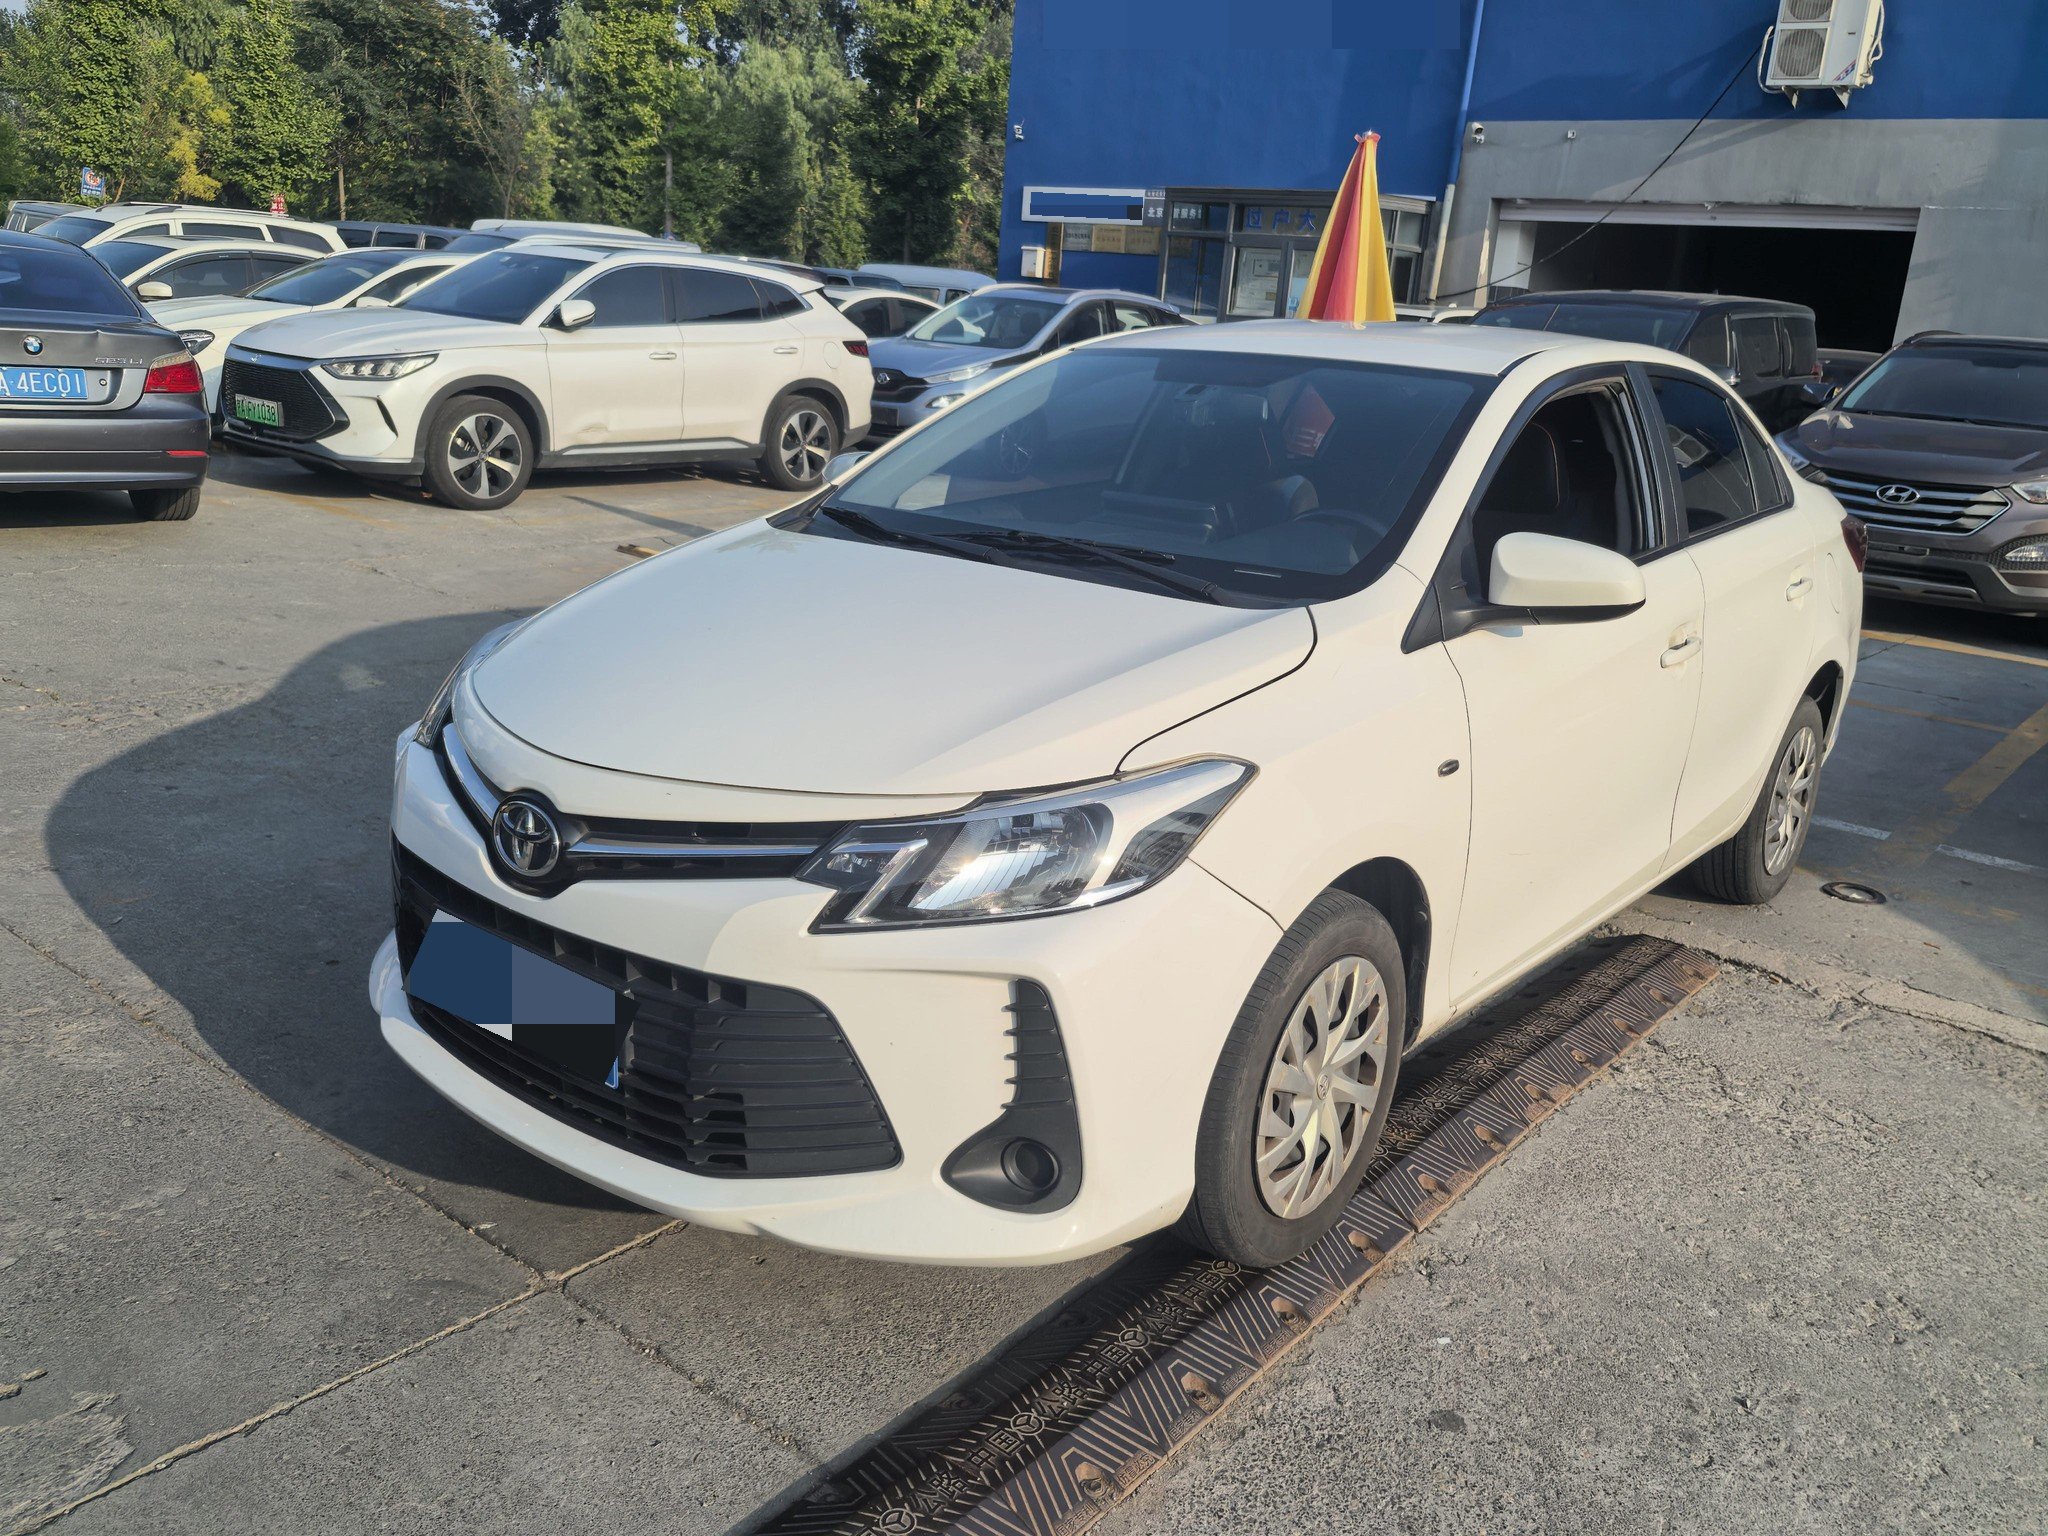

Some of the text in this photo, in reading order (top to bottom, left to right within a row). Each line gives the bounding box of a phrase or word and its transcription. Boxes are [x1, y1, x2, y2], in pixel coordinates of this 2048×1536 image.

[1183, 1270, 1227, 1303] 中国
[1080, 1344, 1131, 1382] 中国
[1036, 1380, 1087, 1419] 公路
[966, 1428, 1026, 1473] 中国
[908, 1469, 969, 1515] 公路
